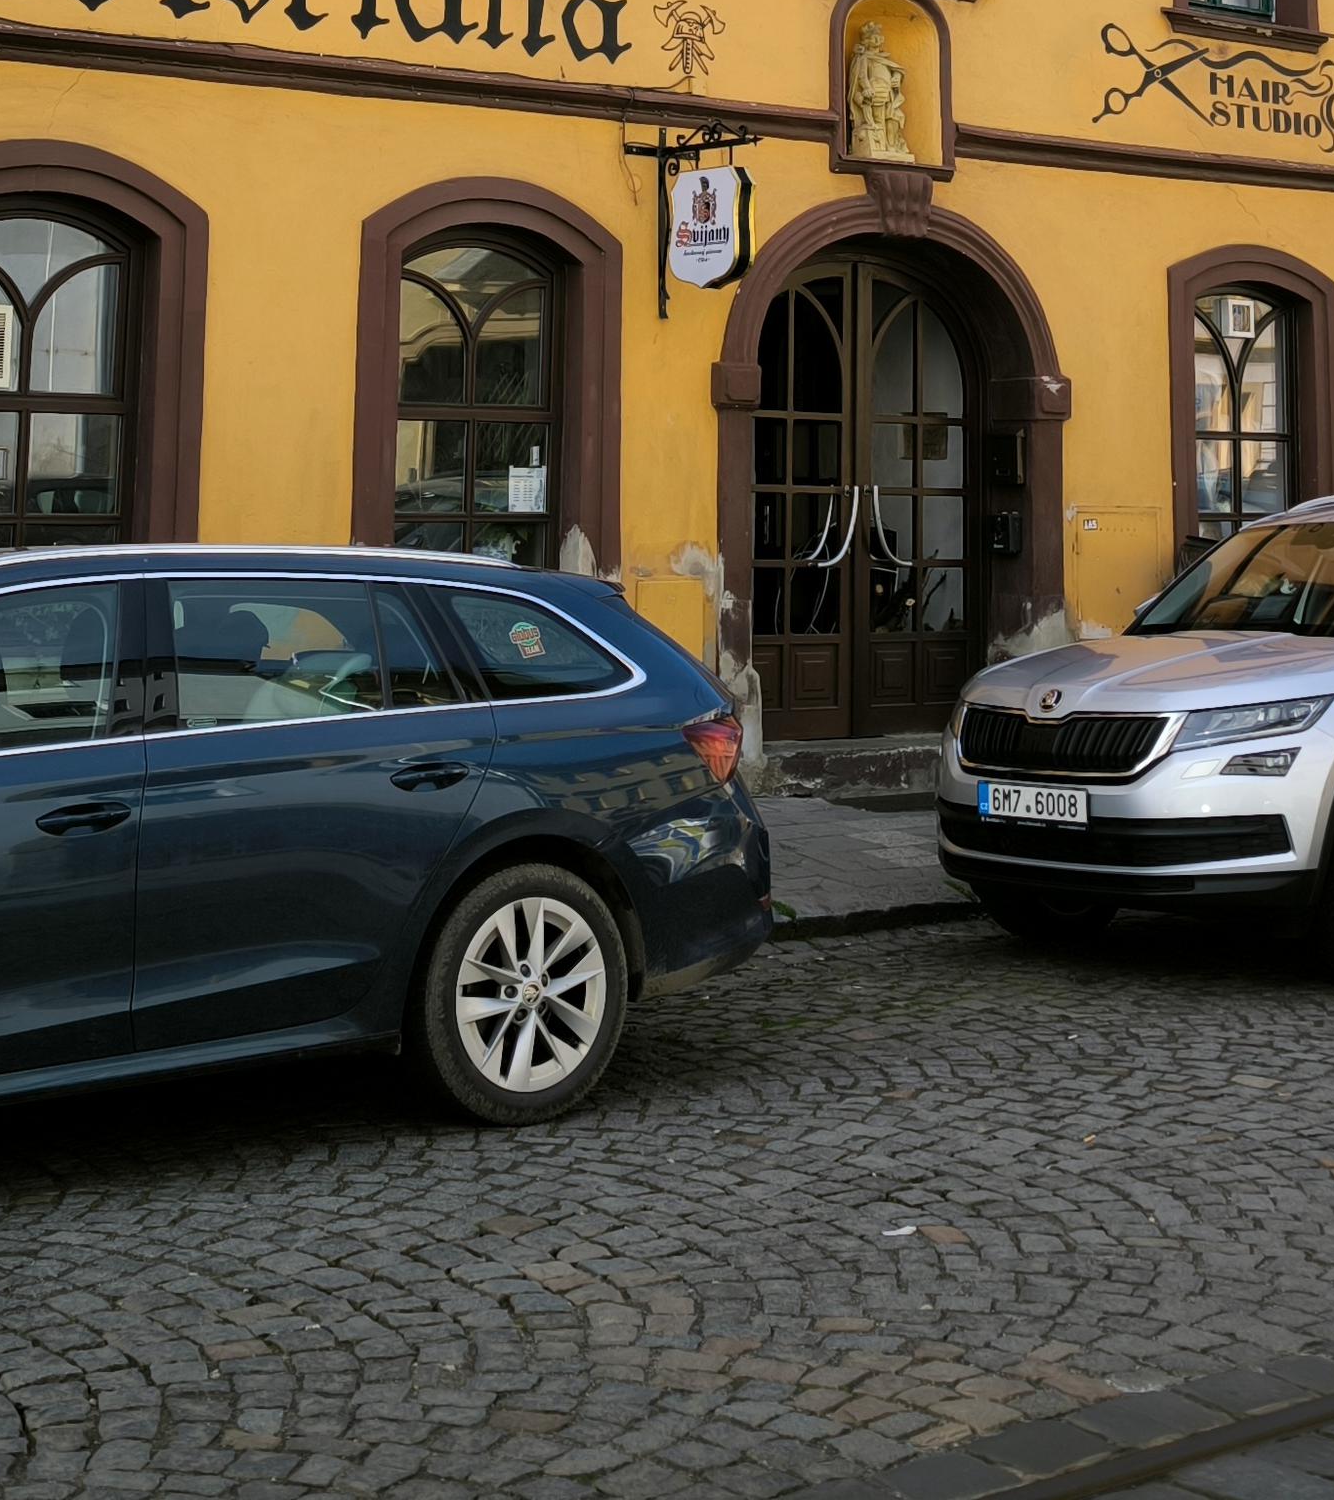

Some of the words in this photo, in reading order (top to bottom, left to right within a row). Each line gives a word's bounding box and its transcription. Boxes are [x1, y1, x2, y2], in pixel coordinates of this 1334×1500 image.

[1210, 72, 1293, 105] HAIR
[1210, 101, 1322, 138] STUDIO
[992, 787, 1021, 813] 6M7
[1035, 791, 1078, 818] 6008
